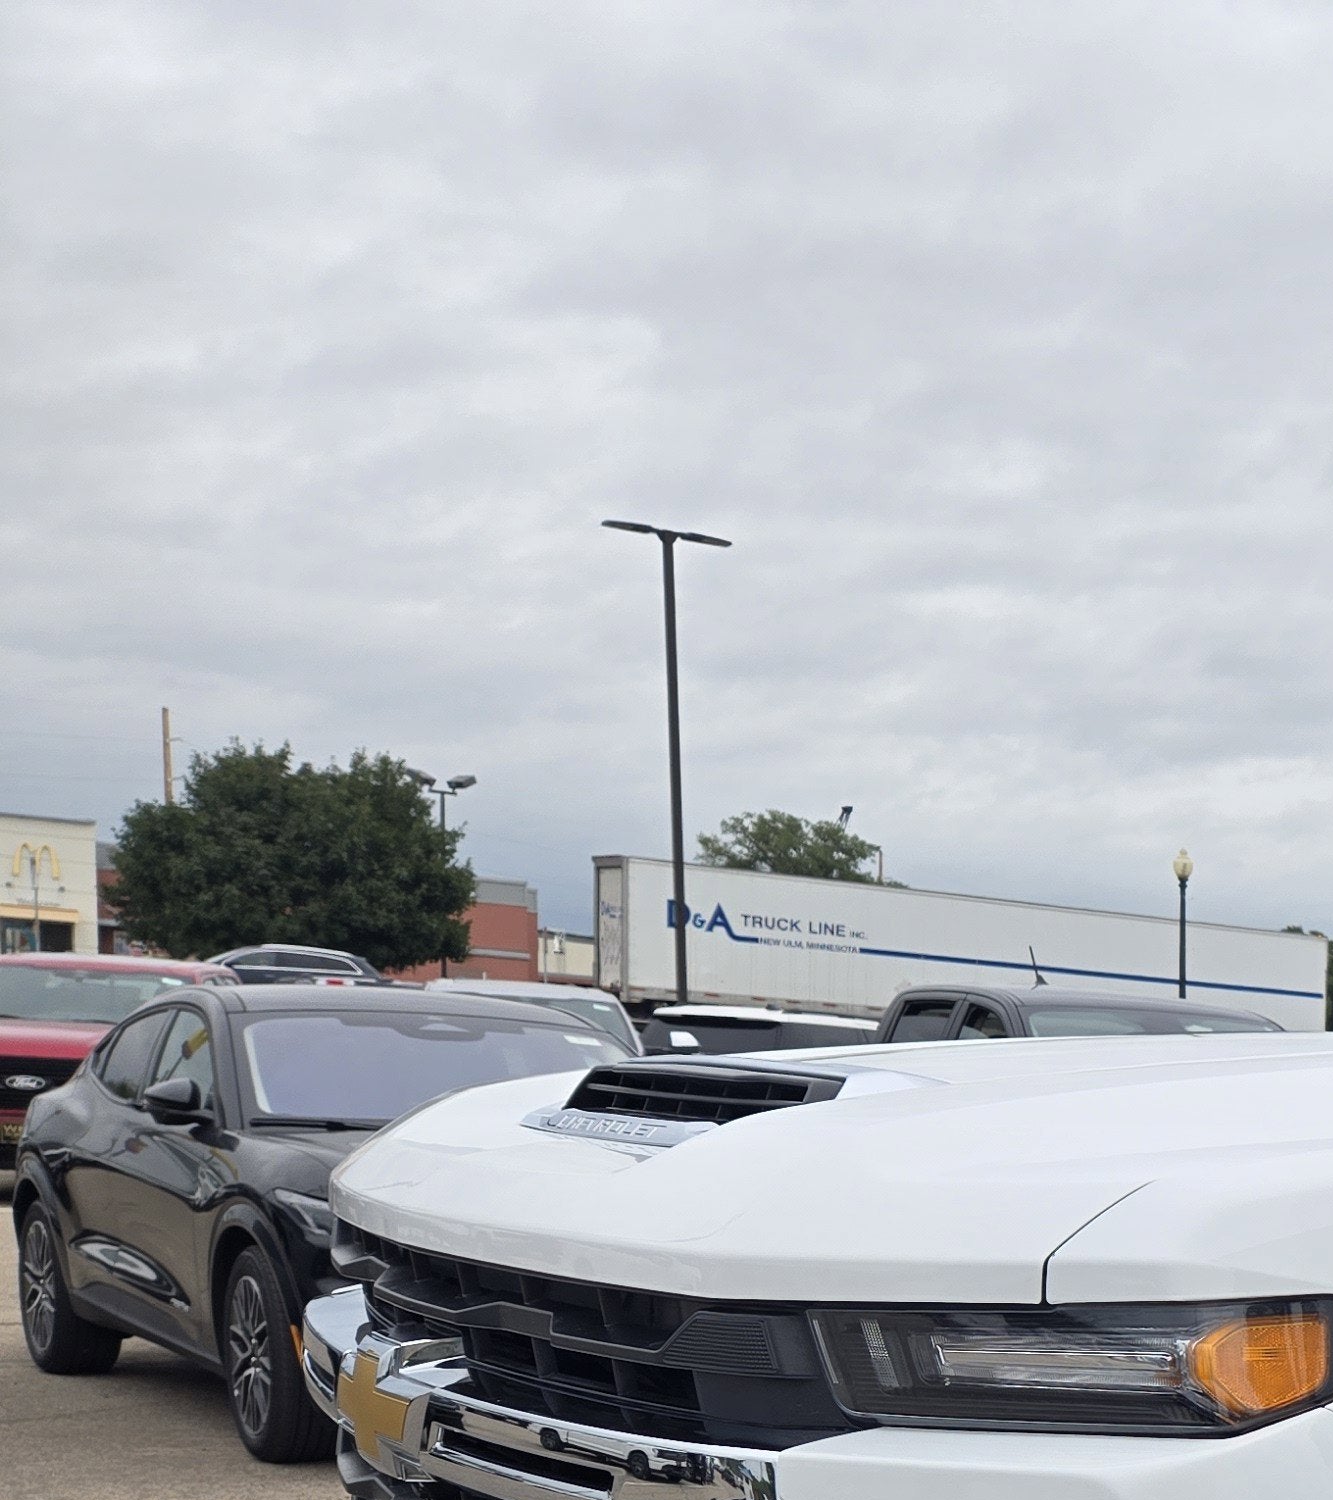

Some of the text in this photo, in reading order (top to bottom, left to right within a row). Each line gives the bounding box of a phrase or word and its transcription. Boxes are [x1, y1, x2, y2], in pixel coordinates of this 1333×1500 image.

[741, 913, 801, 932] TRUCK
[809, 921, 846, 938] LINE
[760, 937, 781, 947] NEW
